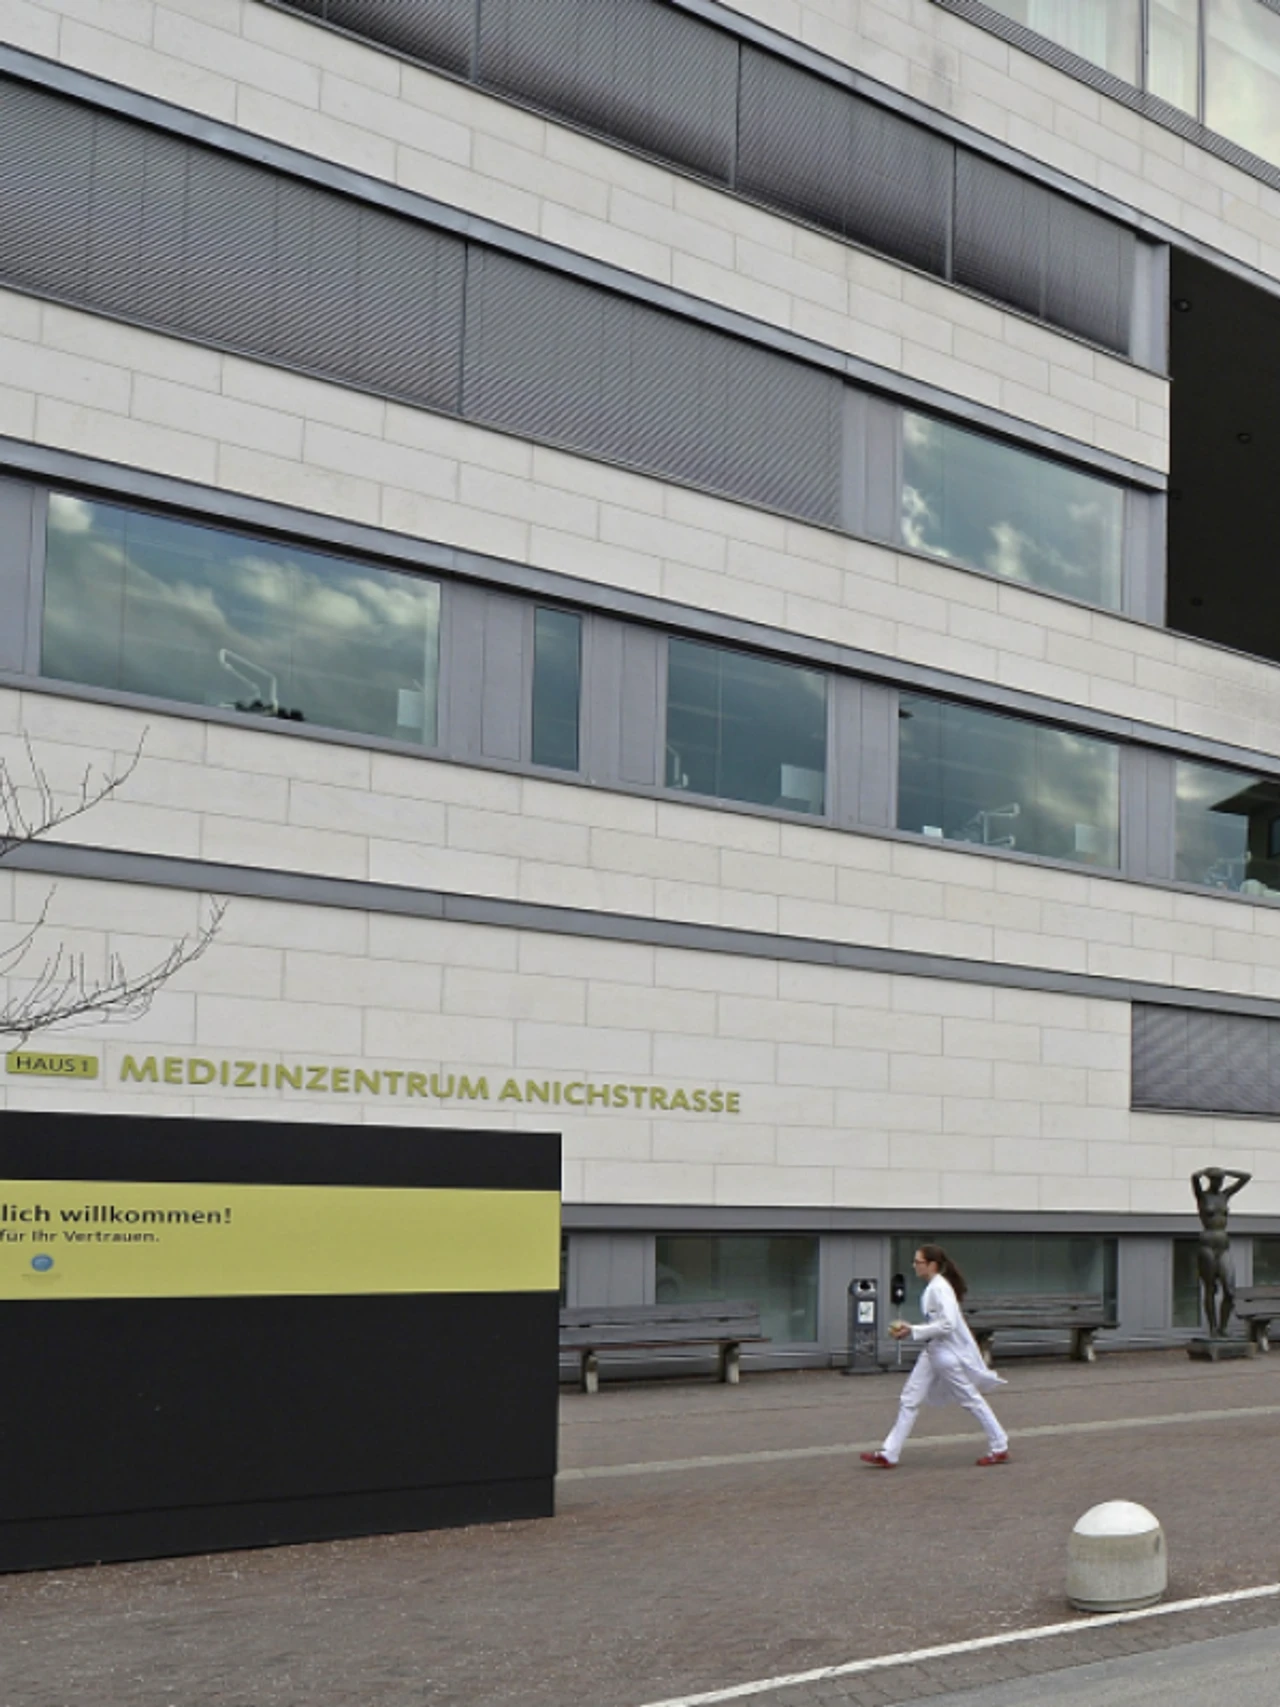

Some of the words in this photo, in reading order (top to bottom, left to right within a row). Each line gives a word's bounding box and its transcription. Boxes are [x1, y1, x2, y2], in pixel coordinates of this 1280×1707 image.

[16, 1056, 76, 1072] HAUS
[81, 1060, 89, 1073] 1
[119, 1054, 490, 1101] MEDIZINZENTRUM
[498, 1077, 742, 1114] ANICHSTRASSE
[60, 1204, 233, 1224] willkommen!
[31, 1230, 58, 1243] Ihr
[63, 1230, 161, 1243] Vertrauen.
